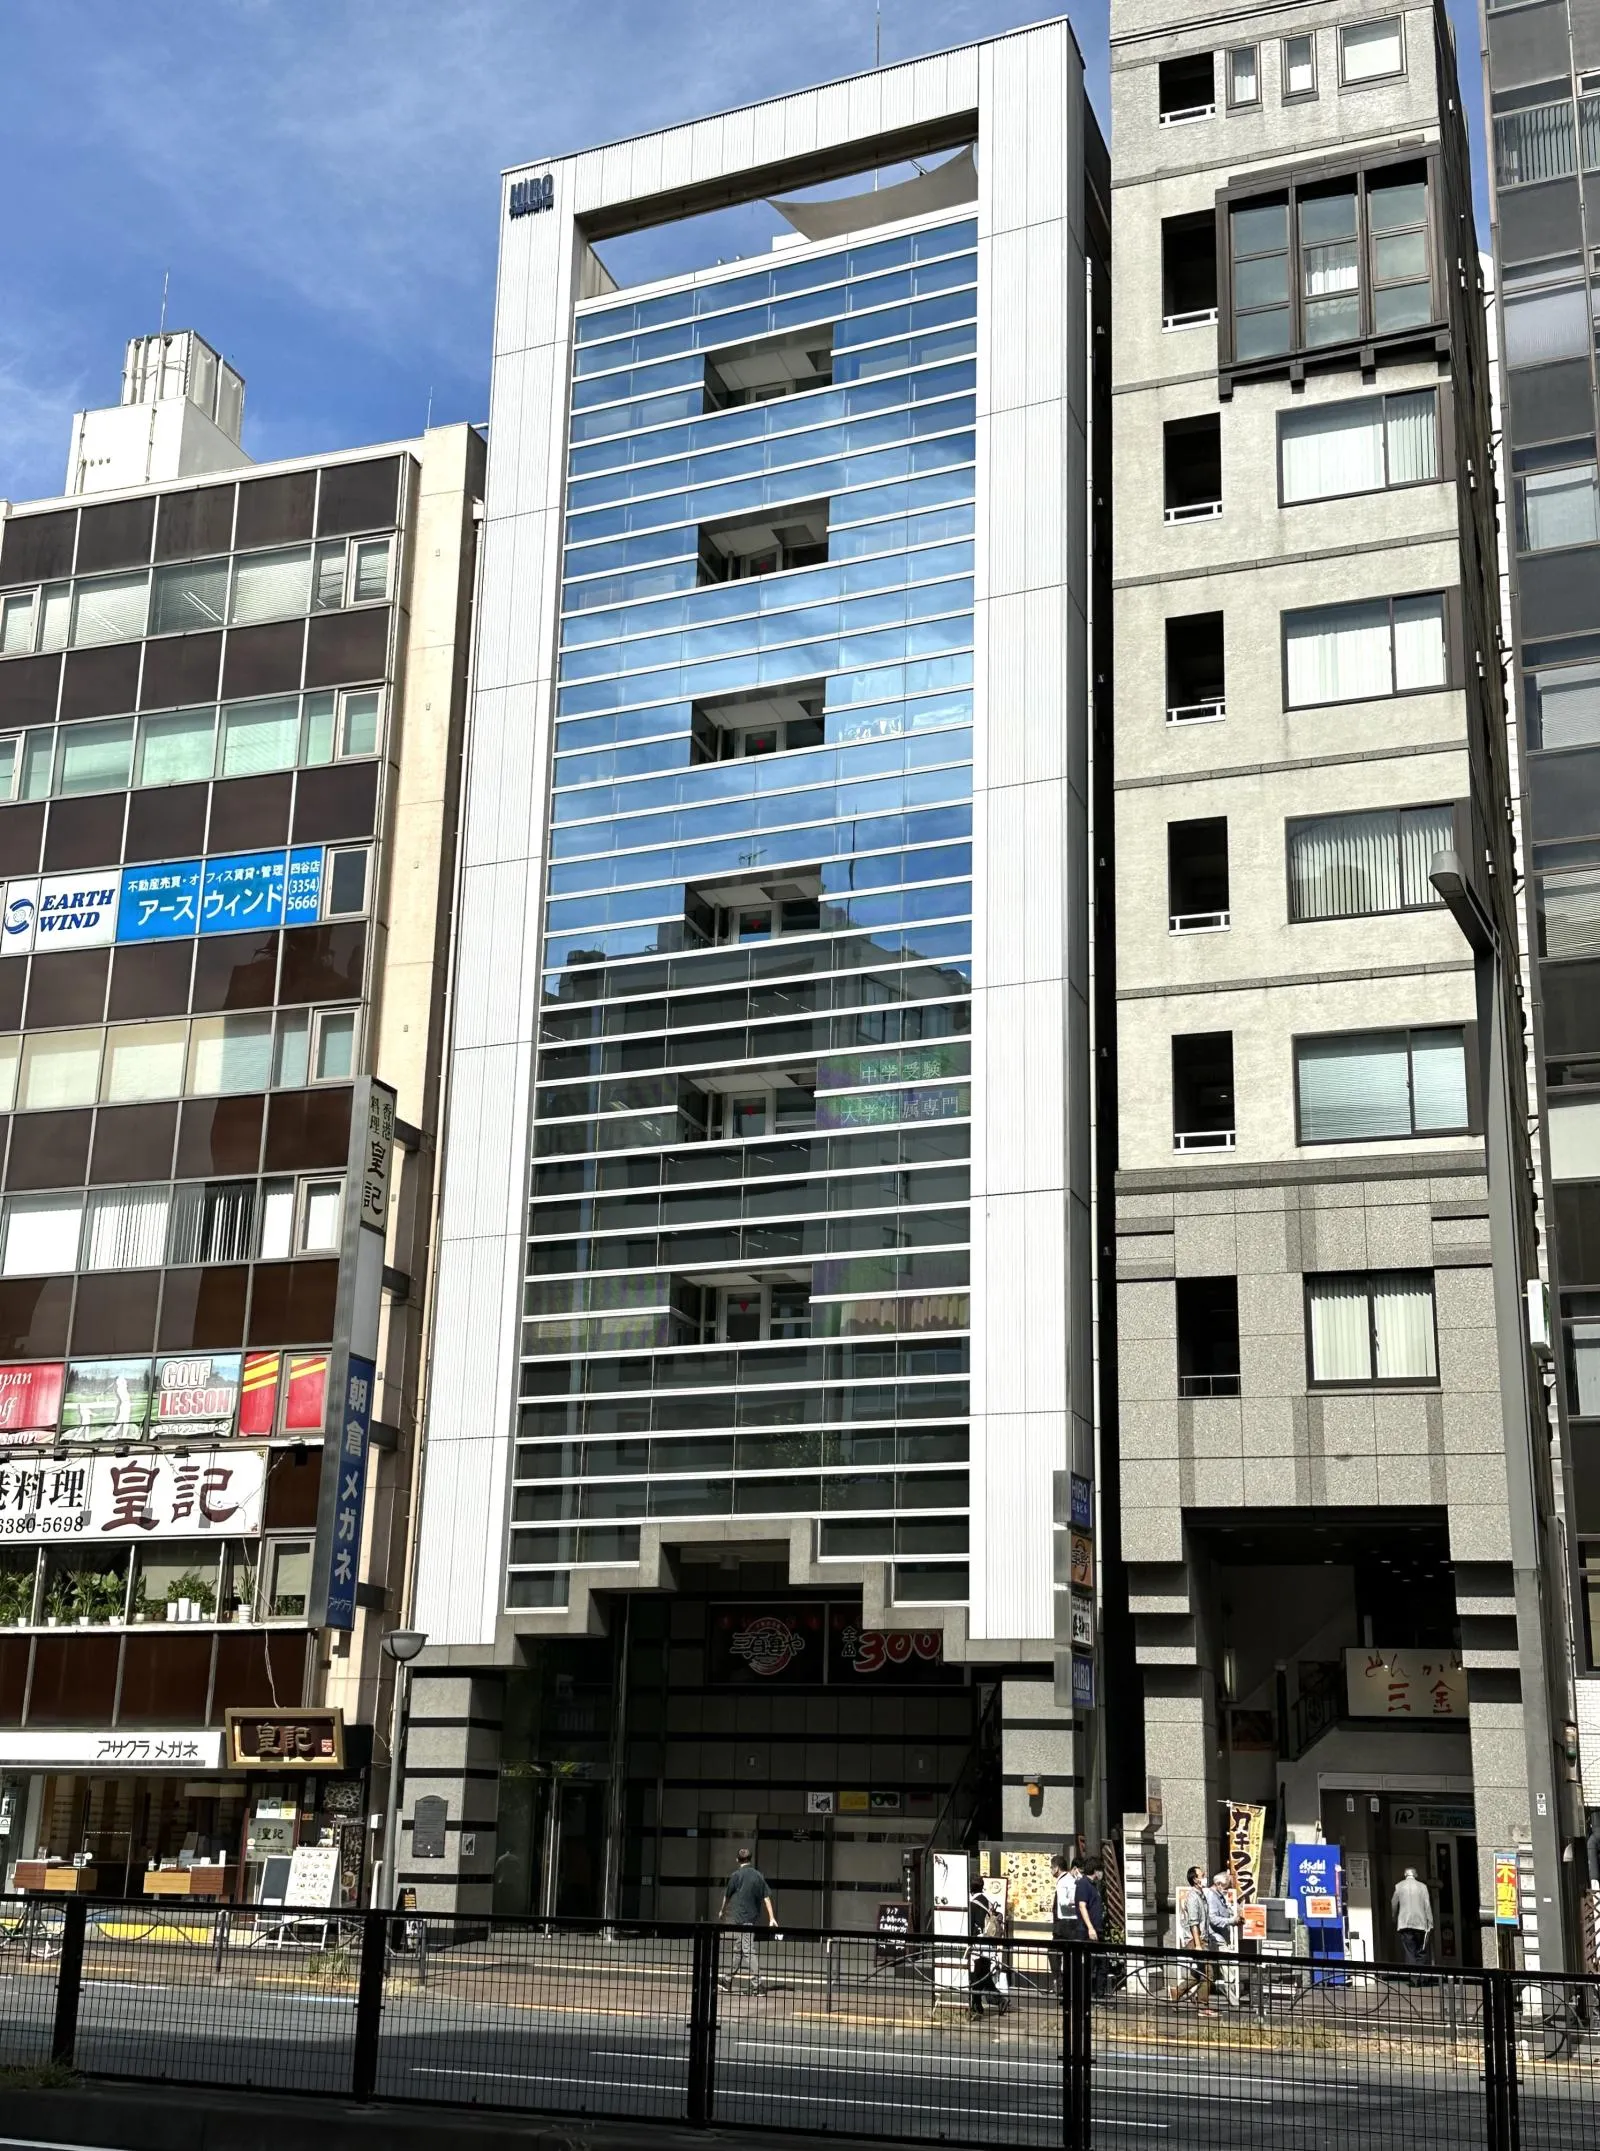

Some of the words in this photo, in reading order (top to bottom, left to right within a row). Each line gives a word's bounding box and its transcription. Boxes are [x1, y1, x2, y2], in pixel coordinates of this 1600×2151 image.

[290, 860, 320, 875] 四谷店
[288, 875, 320, 895] (3354)
[40, 889, 115, 911] EARTH
[137, 883, 284, 926] アースウィンド
[287, 896, 318, 911] 5666
[40, 911, 100, 932] WIND
[861, 1060, 941, 1084] 中学受験
[840, 1096, 959, 1123] 大学付属専門
[363, 1140, 387, 1216] 皇記
[162, 1360, 212, 1390] GOLF
[159, 1388, 231, 1417] LESSON
[334, 1376, 368, 1585] 朝倉メガネ
[101, 1460, 238, 1531] 皇記
[1073, 1661, 1090, 1691] HIRO
[1387, 1679, 1456, 1714] 三金
[97, 1740, 150, 1758] アサクラ
[155, 1740, 199, 1758] メガネ
[256, 1722, 313, 1756] 皇記
[1299, 1859, 1326, 1871] Asahi
[1300, 1885, 1327, 1895] CALPIS
[1497, 1864, 1517, 1919] 不動産
